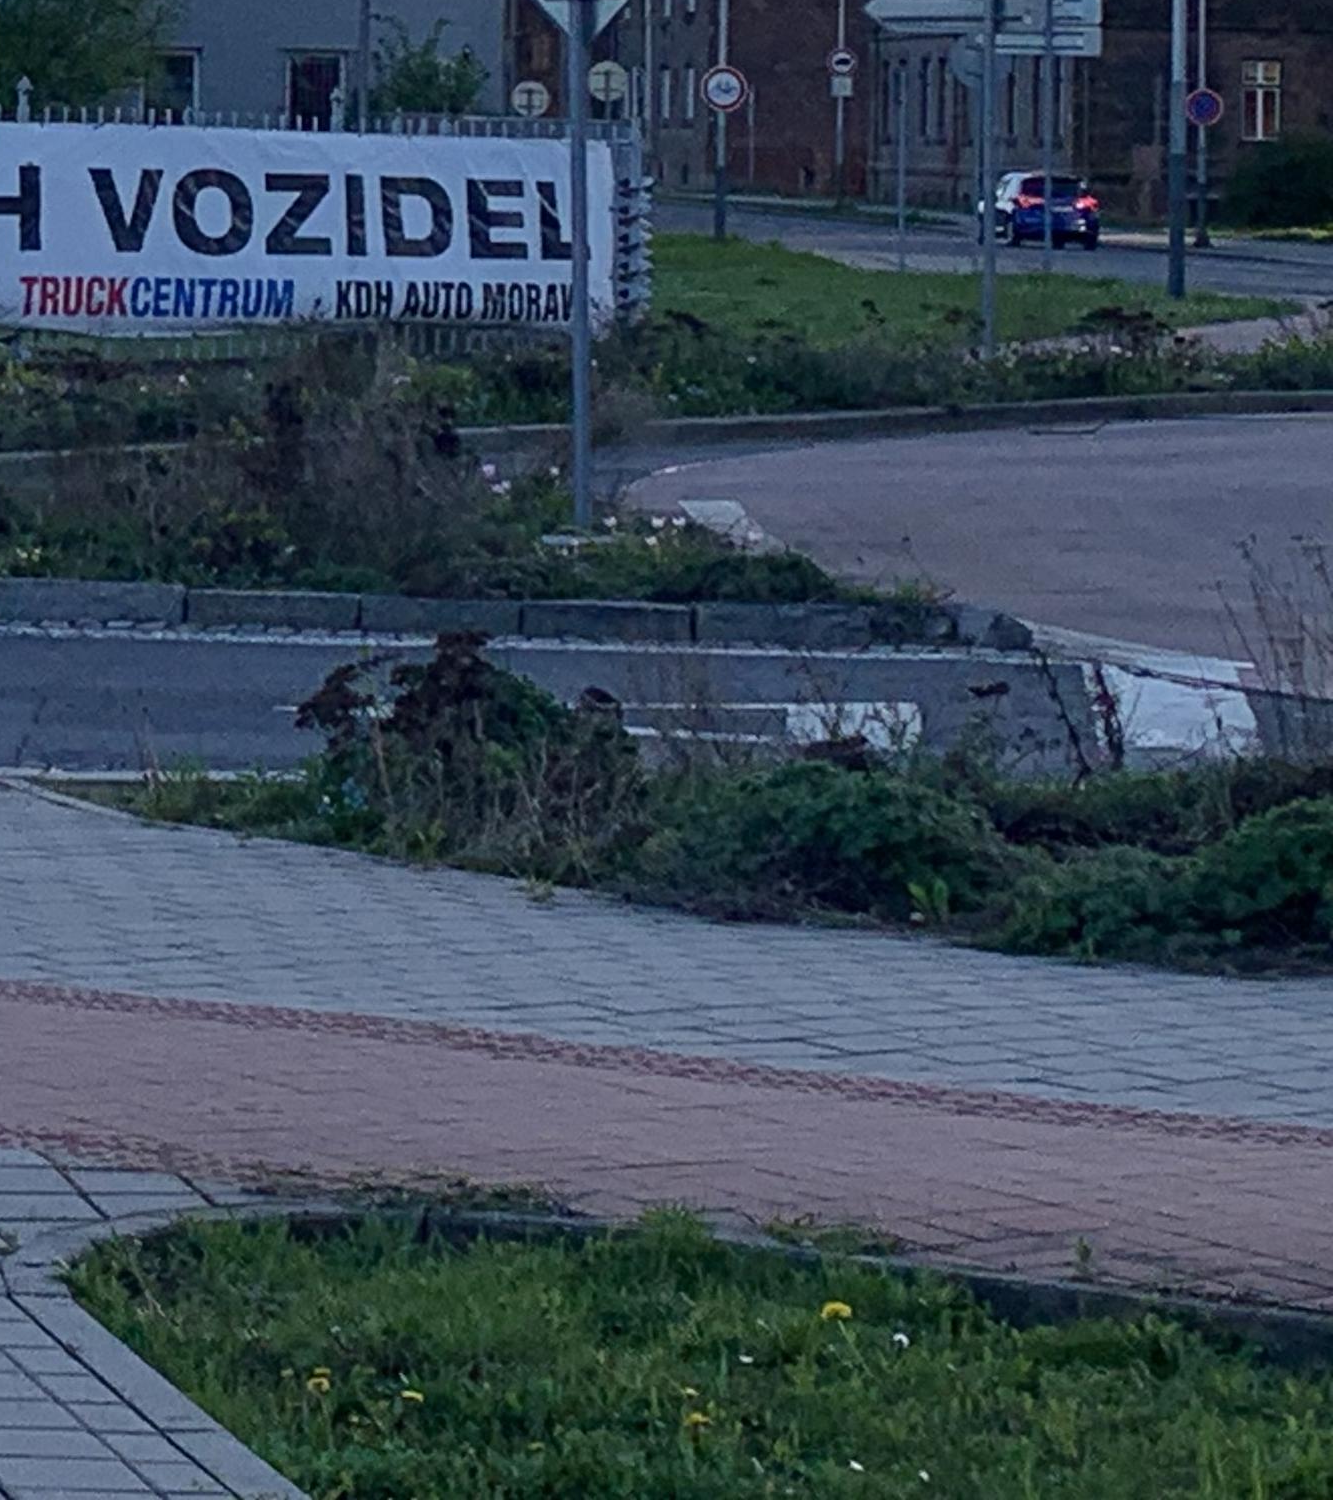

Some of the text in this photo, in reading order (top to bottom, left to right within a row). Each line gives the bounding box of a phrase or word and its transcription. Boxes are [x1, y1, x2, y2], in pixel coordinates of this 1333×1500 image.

[88, 168, 591, 261] VOZIDEL
[19, 275, 294, 319] TRUCKCENTRUM
[335, 279, 392, 319] KDH
[403, 280, 473, 319] AUTO
[482, 281, 574, 321] MORAV
